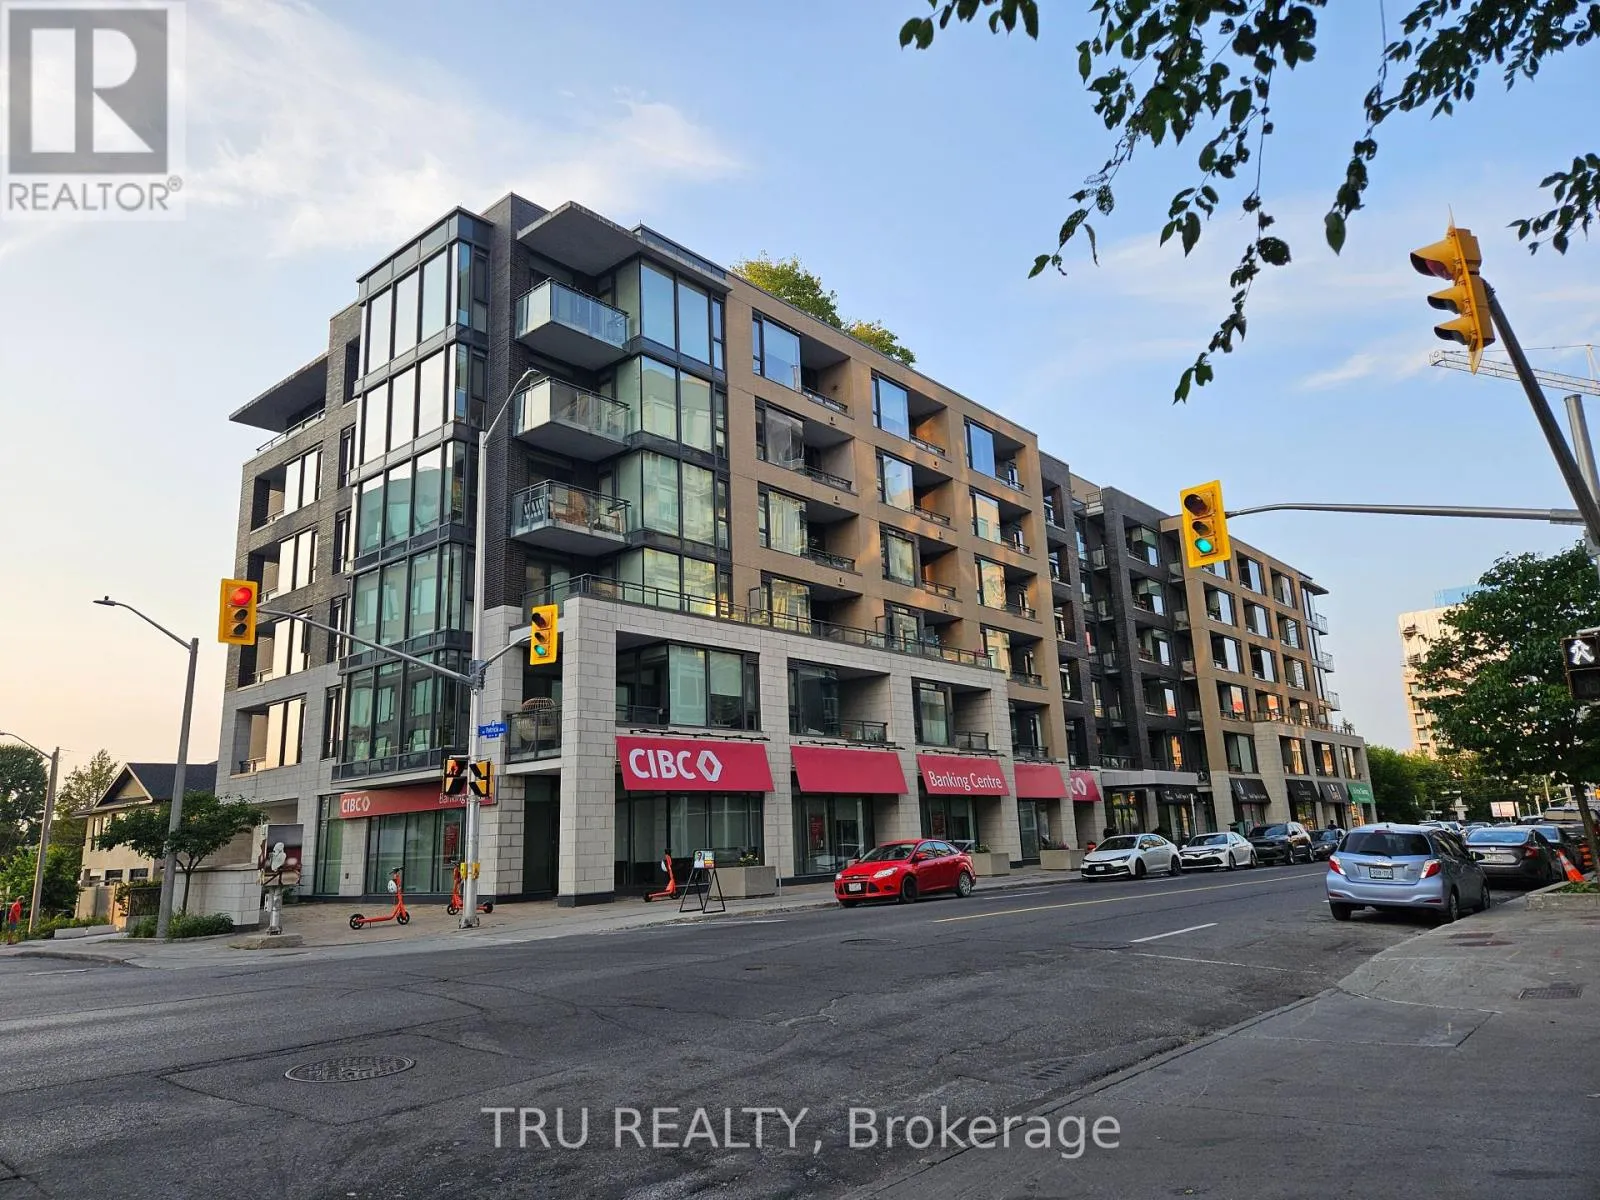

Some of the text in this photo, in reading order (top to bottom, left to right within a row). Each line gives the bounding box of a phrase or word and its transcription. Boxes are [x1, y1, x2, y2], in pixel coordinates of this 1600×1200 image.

[629, 748, 697, 780] CIBC
[928, 770, 1003, 791] Banking Centre
[341, 797, 361, 813] CIBC
